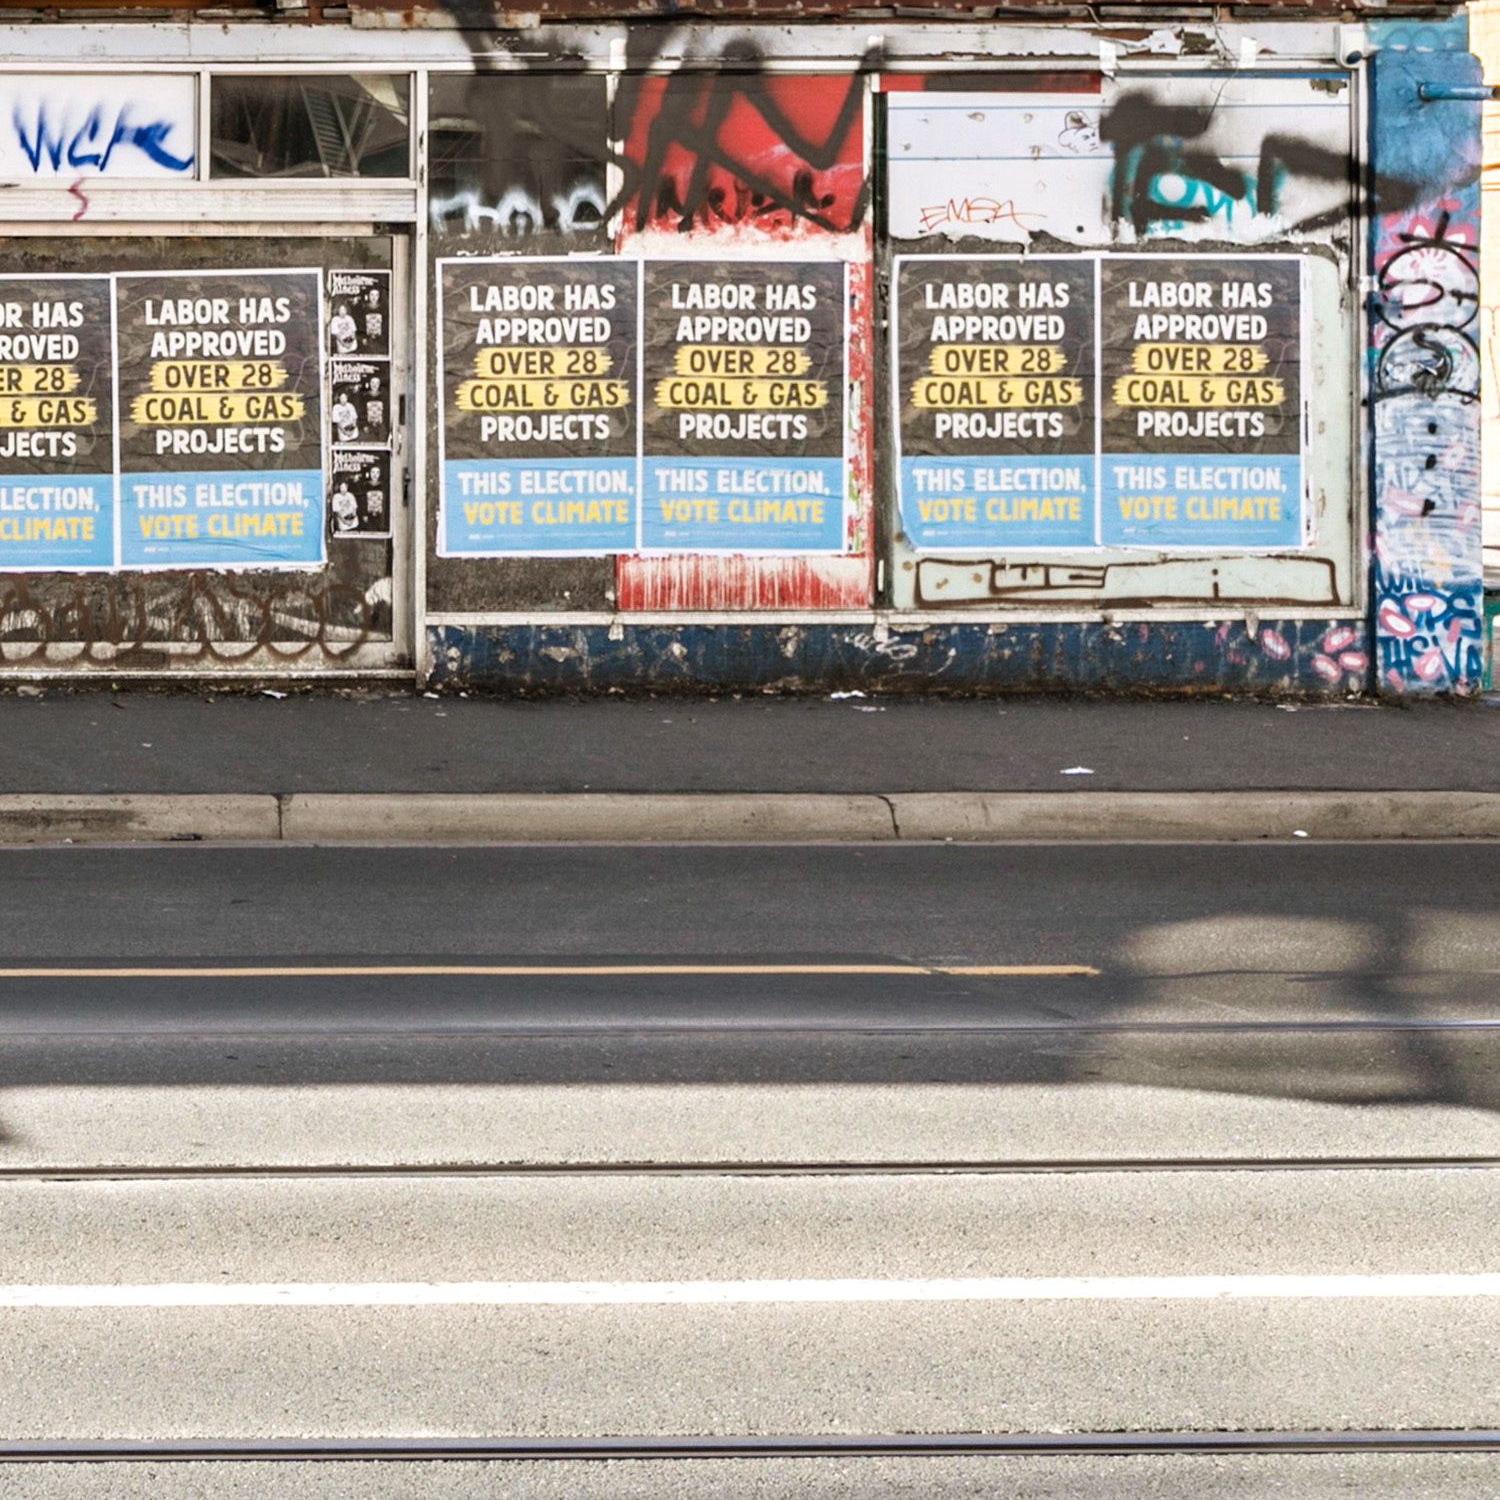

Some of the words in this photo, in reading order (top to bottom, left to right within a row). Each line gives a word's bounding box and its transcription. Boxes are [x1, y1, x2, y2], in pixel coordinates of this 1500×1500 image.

[470, 286, 555, 312] LABOR
[565, 284, 617, 312] HAS
[671, 284, 755, 311] LABOR
[765, 284, 817, 311] HAS
[925, 284, 1009, 310] LABOR
[1019, 283, 1070, 310] HAS
[1128, 283, 1212, 309] LABOR
[1222, 282, 1273, 309] HAS
[32, 301, 84, 328] HAS
[145, 298, 230, 326] LABOR
[239, 297, 291, 324] HAS
[475, 317, 612, 345] APPROVED
[676, 316, 811, 343] APPROVED
[930, 315, 1065, 342] APPROVED
[1133, 315, 1267, 341] APPROVED
[150, 330, 286, 358] APPROVED
[490, 350, 555, 376] OVER
[567, 349, 599, 375] 28
[690, 349, 754, 374] OVER
[766, 348, 797, 374] 28
[944, 348, 1009, 373] OVER
[1021, 347, 1052, 372] 28
[1147, 347, 1211, 372] OVER
[1223, 346, 1254, 371] 28
[34, 366, 65, 391] 28
[165, 363, 230, 389] OVER
[241, 362, 273, 387] 28
[469, 383, 534, 409] COAL
[544, 383, 560, 407] &
[571, 382, 620, 407] GAS
[669, 382, 732, 407] COAL
[743, 381, 759, 406] &
[769, 381, 817, 406] GAS
[924, 381, 988, 405] COAL
[998, 380, 1014, 404] &
[1024, 380, 1073, 404] GAS
[1127, 380, 1190, 404] COAL
[1200, 379, 1216, 404] &
[1226, 379, 1274, 404] GAS
[11, 399, 27, 424] &
[38, 399, 87, 424] GAS
[145, 396, 209, 421] COAL
[219, 395, 235, 420] &
[245, 394, 294, 420] GAS
[481, 415, 610, 442] PROJECTS
[679, 414, 807, 441] PROJECTS
[935, 413, 1063, 439] PROJECTS
[1137, 412, 1264, 438] PROJECTS
[156, 428, 284, 455] PROJECTS
[458, 472, 511, 496] THIS
[520, 470, 634, 499] ELECTION,
[656, 470, 708, 494] THIS
[717, 469, 829, 498] ELECTION,
[913, 468, 965, 492] THIS
[974, 466, 1087, 496] ELECTION,
[1114, 468, 1166, 491] THIS
[1175, 466, 1287, 495] ELECTION,
[134, 485, 186, 509] THIS
[195, 482, 308, 512] ELECTION,
[918, 498, 976, 522] VOTE
[986, 497, 1081, 521] CLIMATE
[1119, 498, 1176, 521] VOTE
[1186, 497, 1281, 521] CLIMATE
[464, 502, 522, 526] VOTE
[532, 500, 629, 525] CLIMATE
[661, 501, 718, 524] VOTE
[728, 500, 823, 524] CLIMATE
[139, 515, 197, 539] VOTE
[207, 513, 303, 538] CLIMATE
